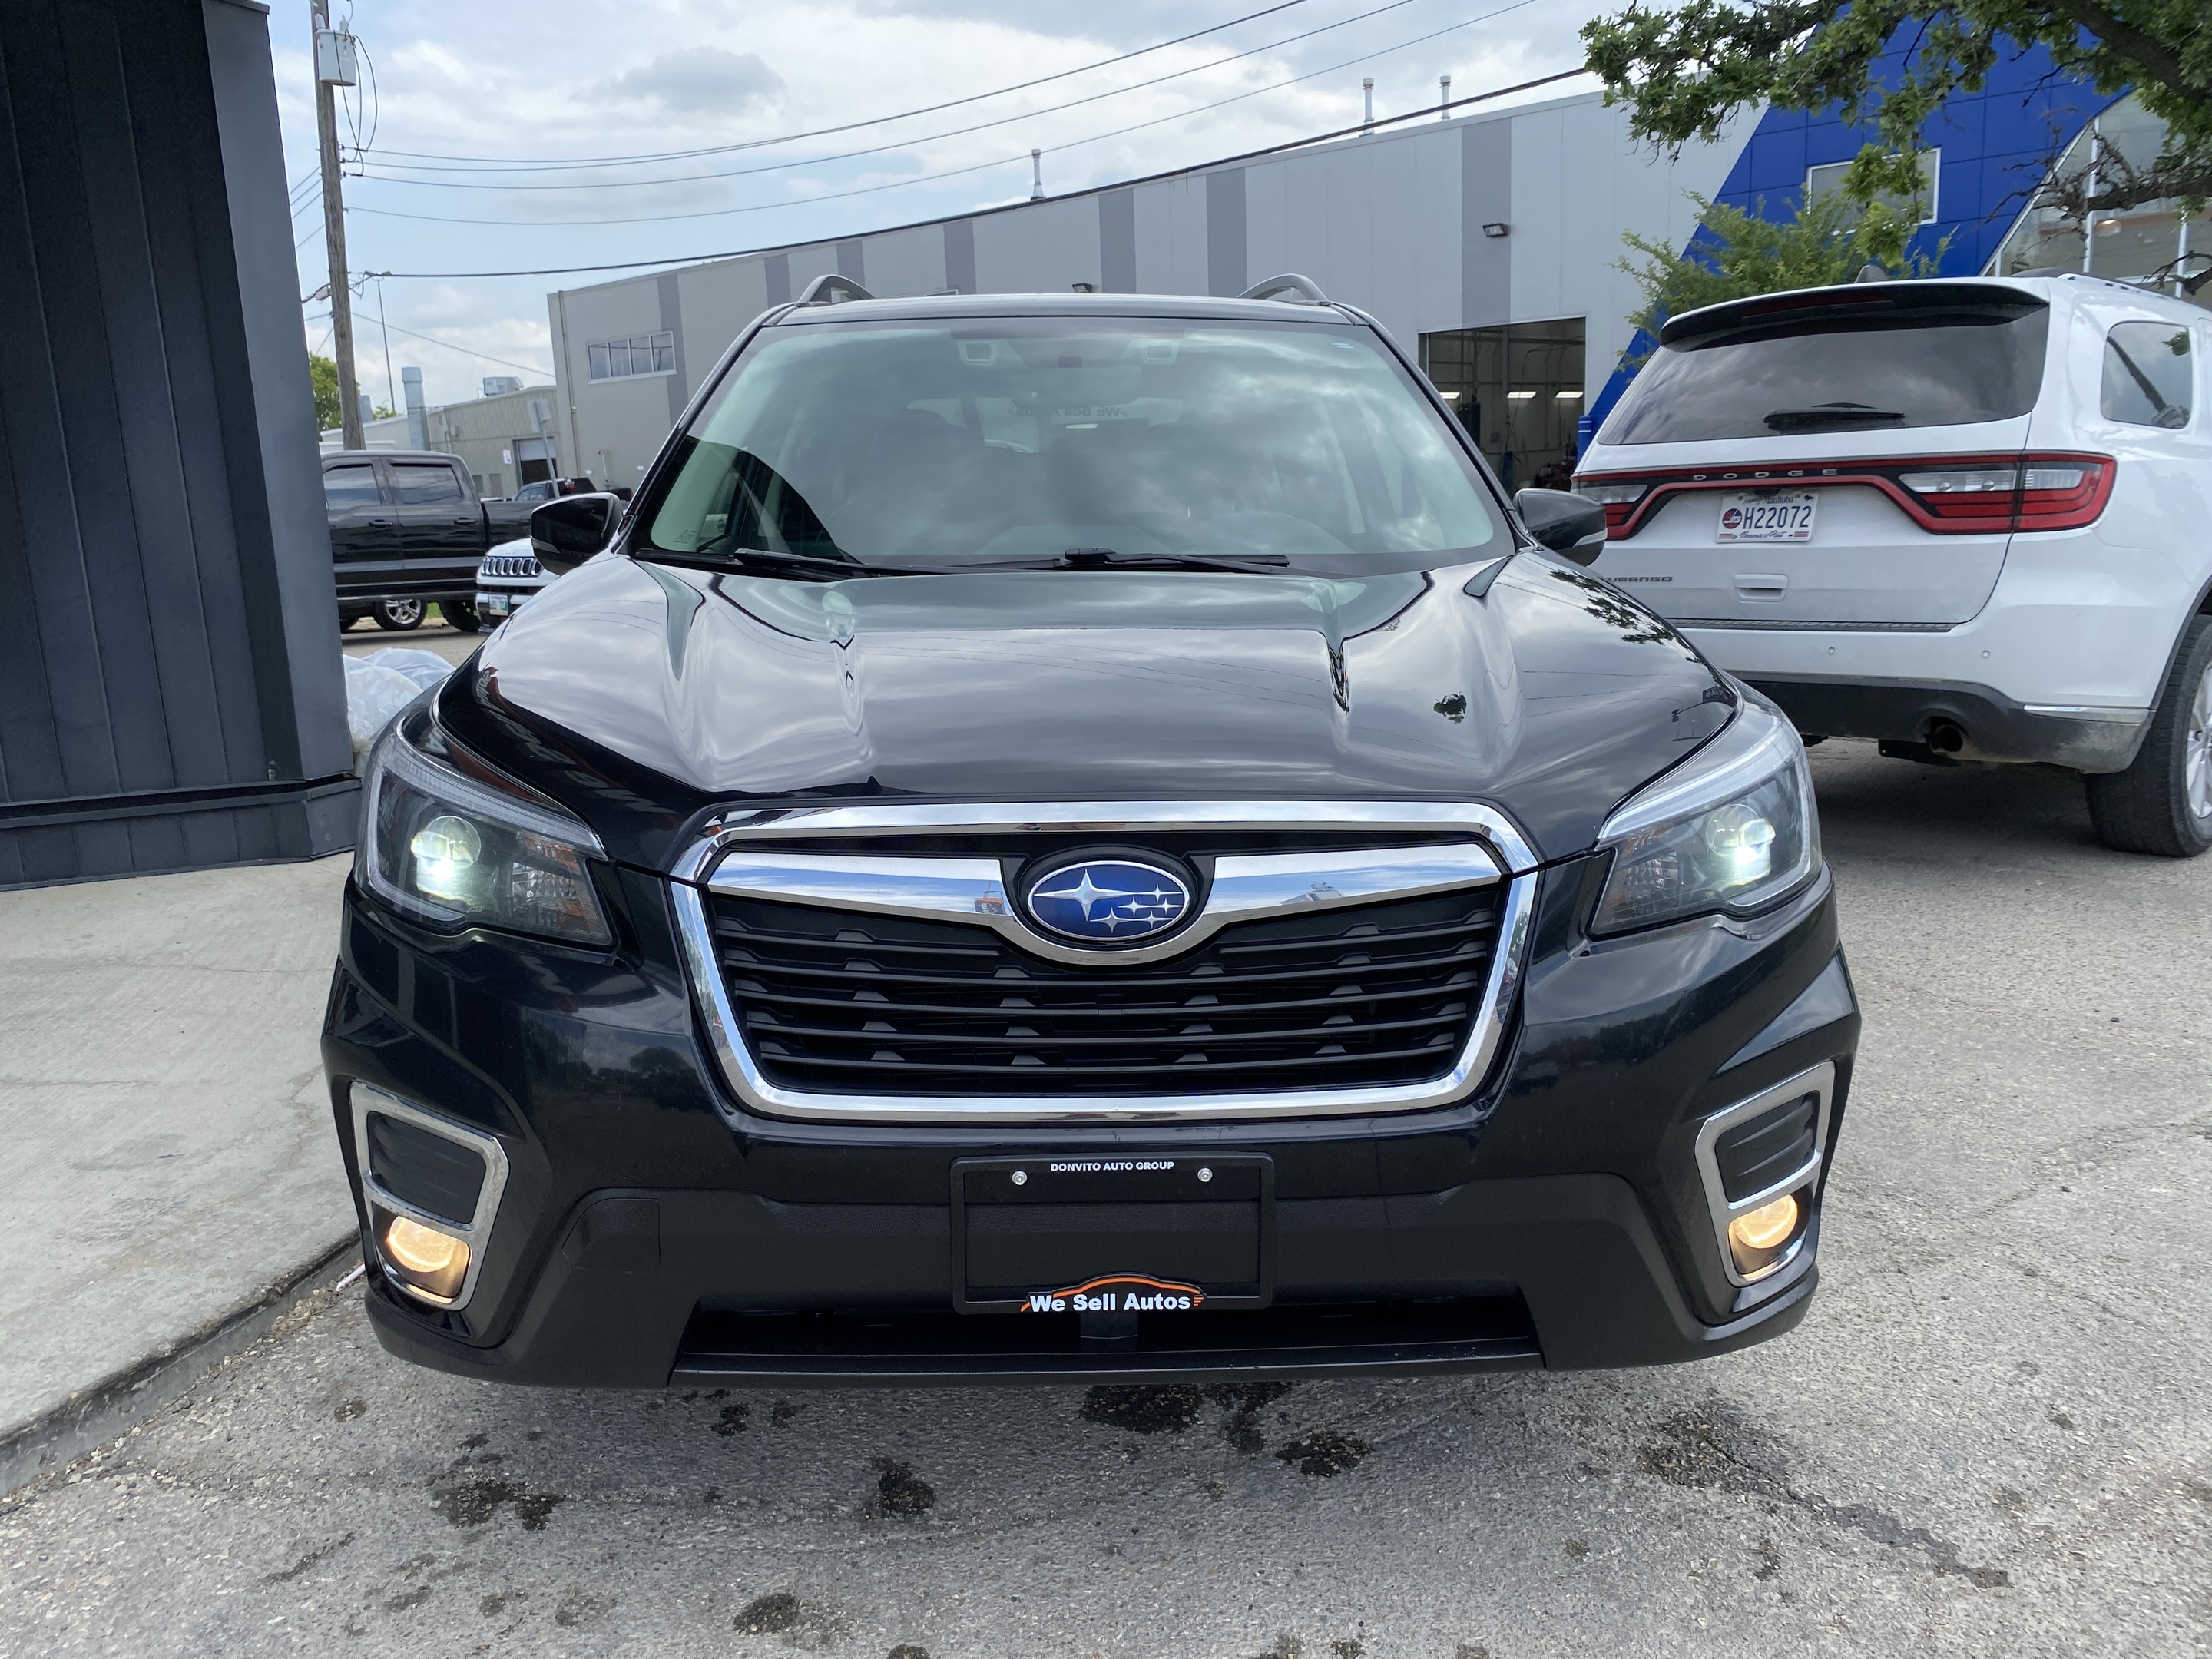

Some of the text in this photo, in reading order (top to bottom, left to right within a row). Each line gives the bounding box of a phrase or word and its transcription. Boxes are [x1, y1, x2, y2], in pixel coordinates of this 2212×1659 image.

[1693, 468, 1838, 481] DODGE
[1743, 505, 1812, 530] H22072
[1051, 1161, 1175, 1172] DONVITO AUTO GROUP
[1029, 1293, 1191, 1313] We Sell Autos
